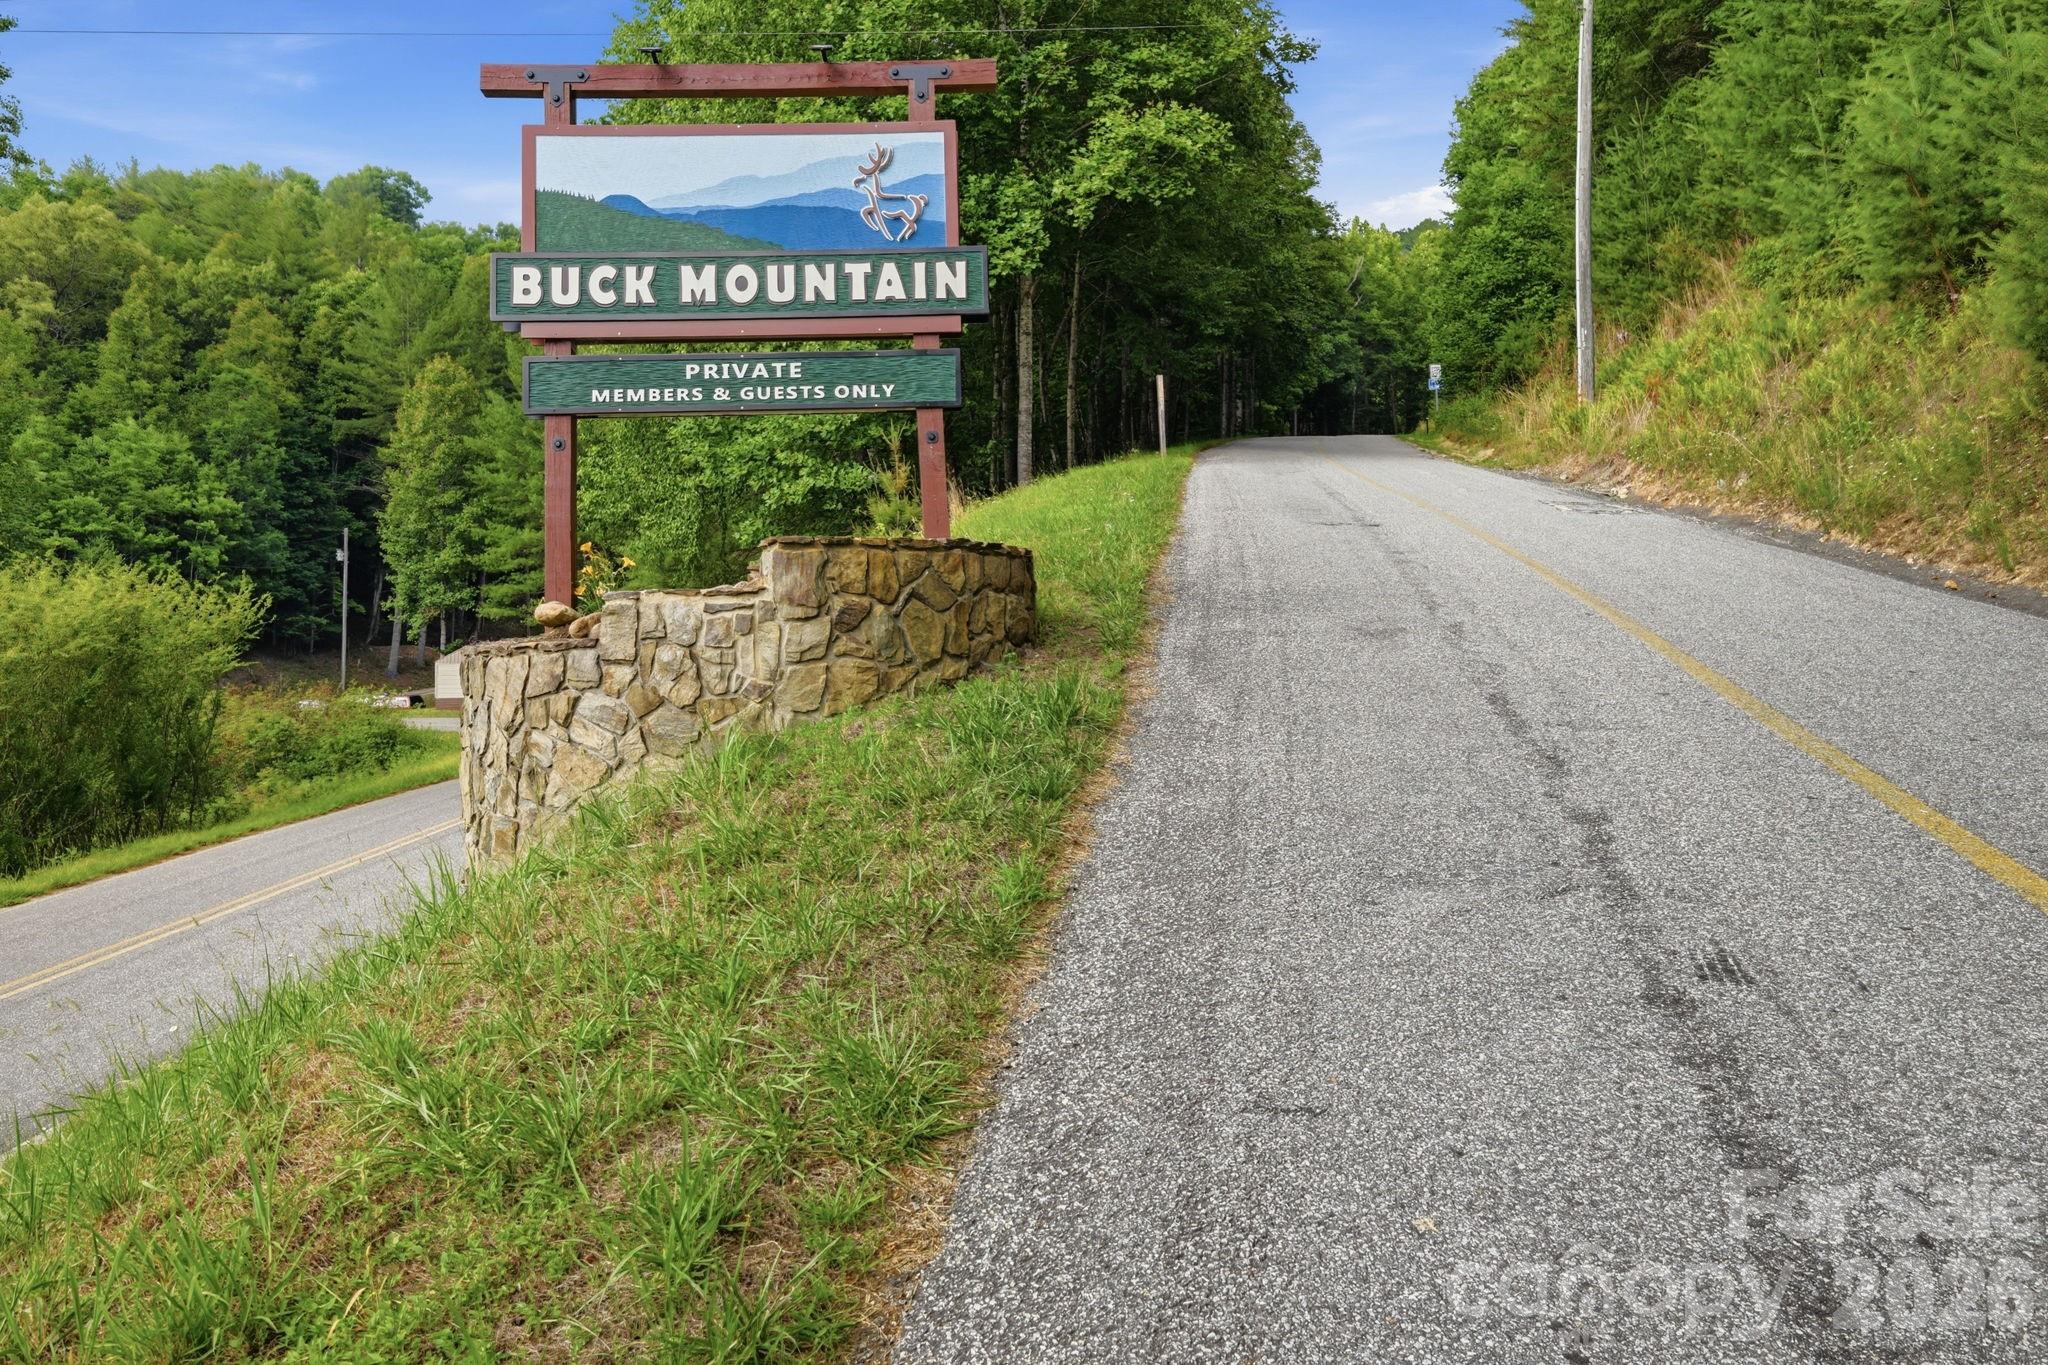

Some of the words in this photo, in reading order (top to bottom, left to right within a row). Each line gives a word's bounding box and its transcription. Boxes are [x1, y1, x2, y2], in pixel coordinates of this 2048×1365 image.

[512, 264, 657, 306] BUCK
[680, 260, 968, 306] MOUNTAIN
[685, 362, 803, 380] PRIVATE
[591, 387, 703, 403] MEMBERS
[713, 387, 732, 401] &
[740, 385, 826, 401] GUESTS
[834, 383, 897, 398] ONLY
